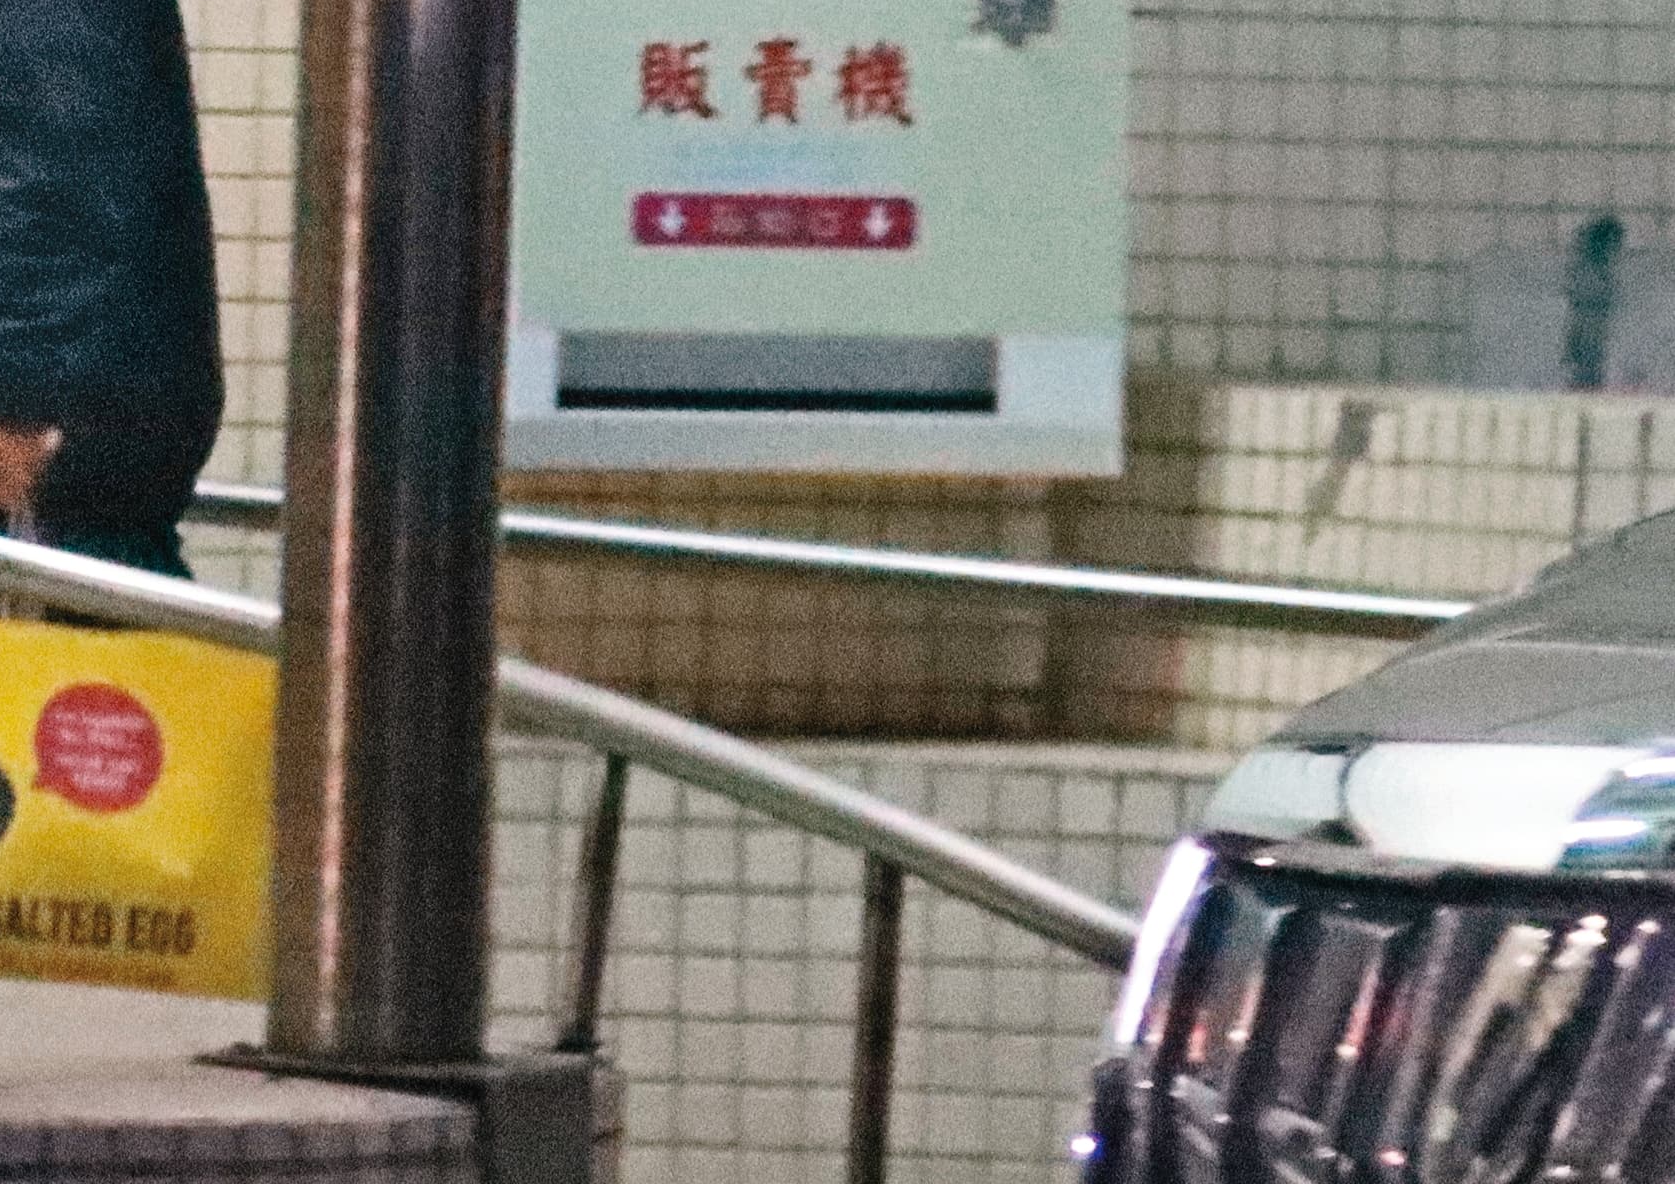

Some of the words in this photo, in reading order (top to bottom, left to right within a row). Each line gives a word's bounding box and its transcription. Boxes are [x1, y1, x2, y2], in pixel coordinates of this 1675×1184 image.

[639, 37, 915, 127] 販賣機
[127, 904, 197, 955] EGG
